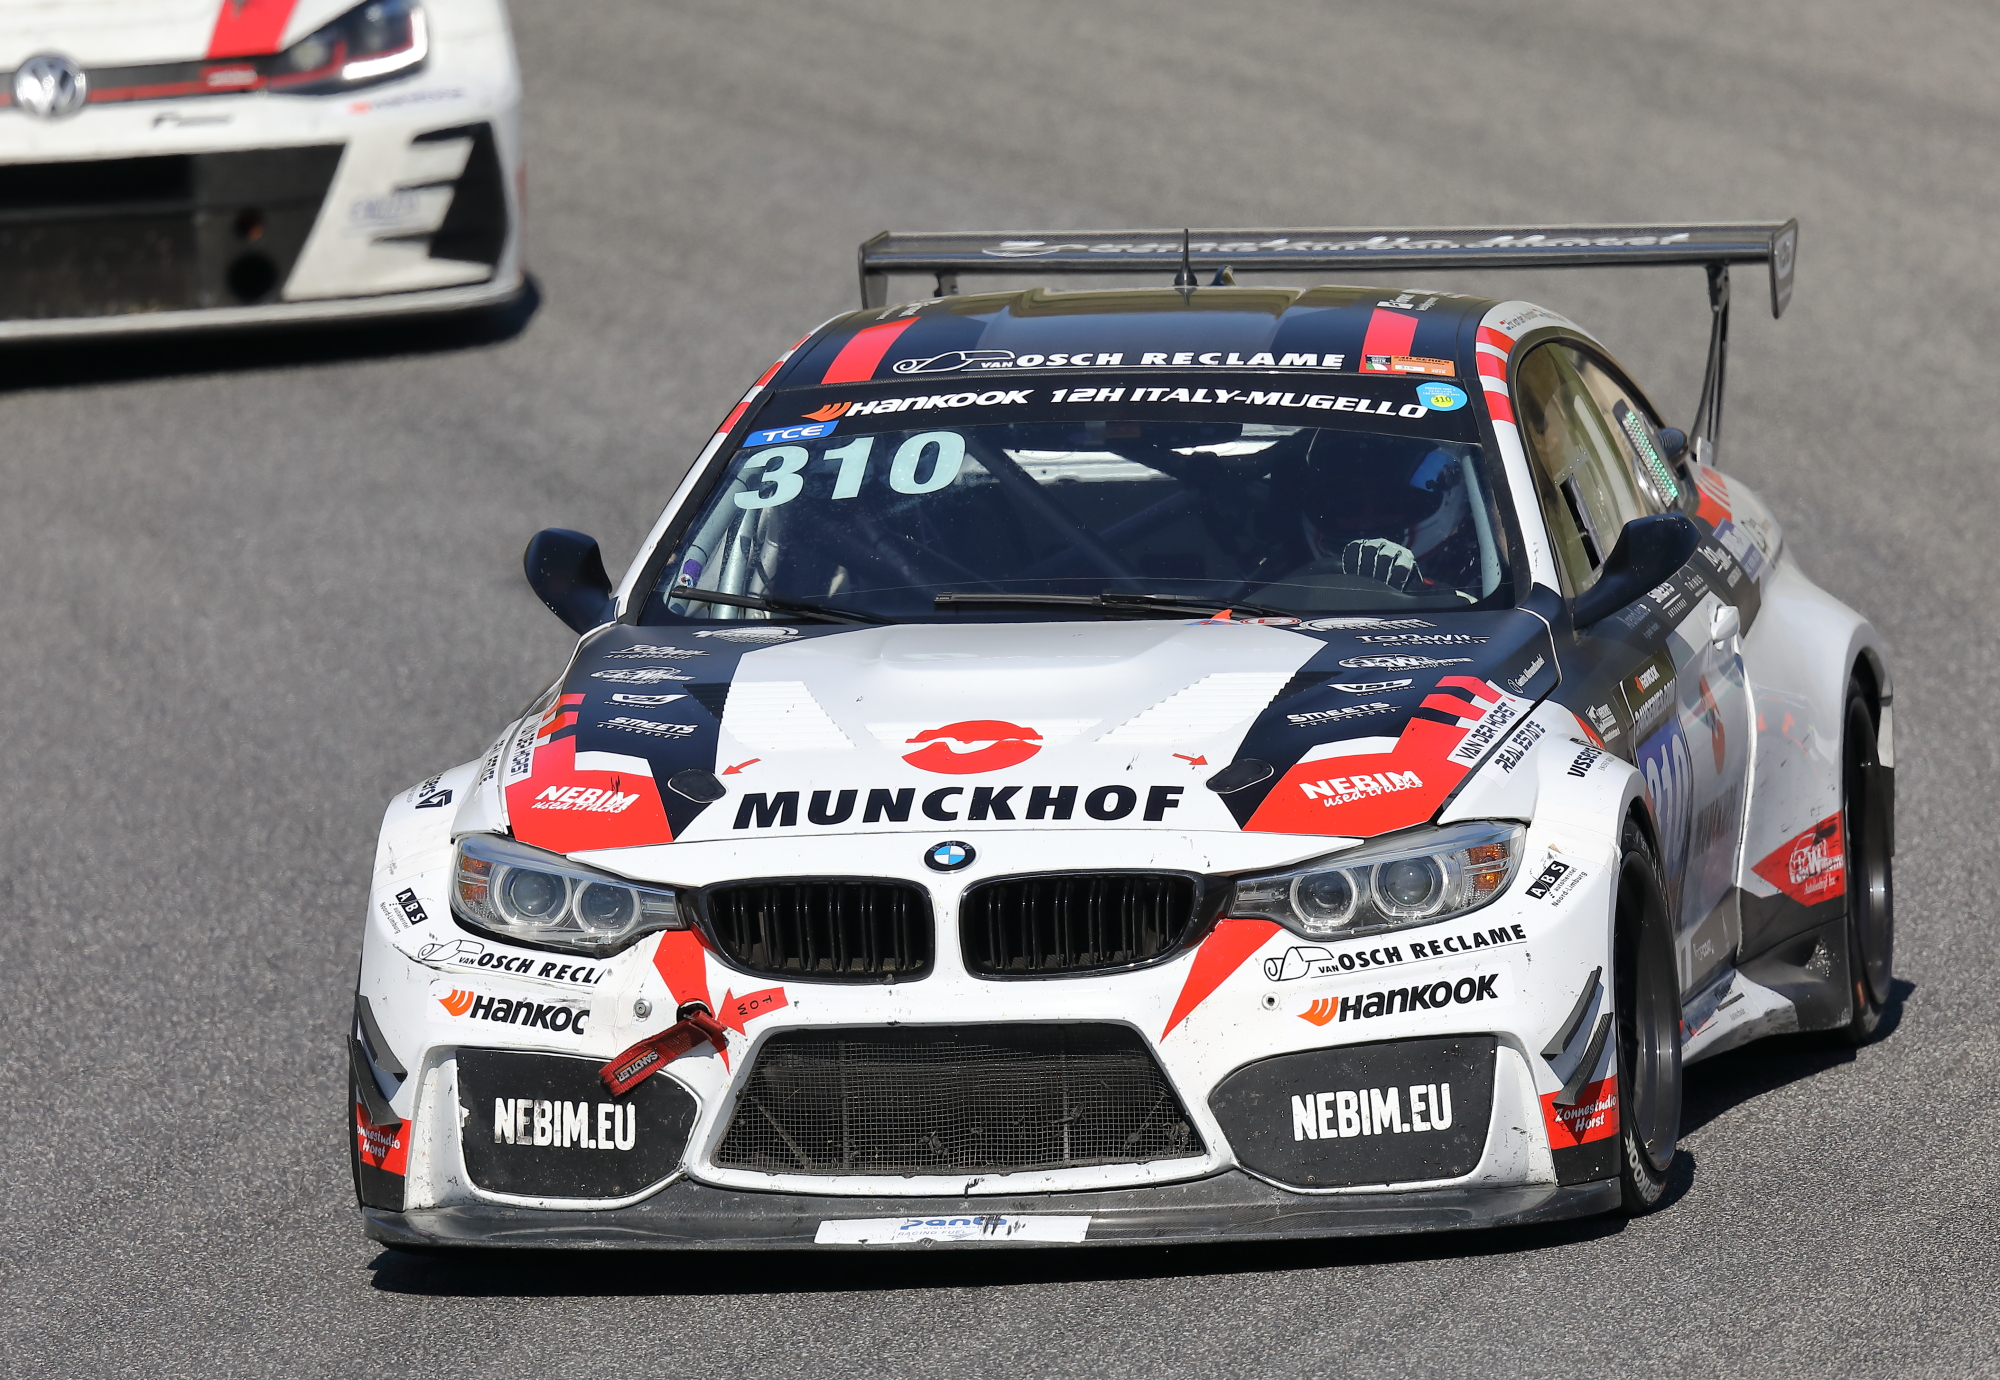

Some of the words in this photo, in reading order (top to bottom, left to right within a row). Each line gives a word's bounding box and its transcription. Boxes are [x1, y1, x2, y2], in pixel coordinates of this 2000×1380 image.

[980, 361, 1014, 369] VAN
[1016, 353, 1124, 367] OSCH
[1140, 352, 1346, 368] RECLAME
[1051, 387, 1127, 403] 12H
[1129, 387, 1428, 419] ITALY-MUGELLO
[762, 425, 825, 442] TCE
[734, 431, 966, 510] 310
[608, 716, 698, 734] SMEETS
[1286, 702, 1391, 724] SMEETS
[1484, 702, 1518, 729] HORST
[1471, 724, 1498, 744] DER
[1495, 745, 1525, 774] REAL
[1512, 720, 1546, 751] ESTATE
[1456, 739, 1485, 760] VAN
[535, 785, 640, 811] NEBIM
[1298, 770, 1419, 799] NEBIM
[1323, 787, 1366, 808] used
[1363, 775, 1424, 798] trucks
[531, 801, 575, 811] used
[732, 785, 1184, 829] MUNCKHOF
[1532, 863, 1567, 897] ABS
[398, 891, 427, 922] ABS
[1318, 964, 1339, 974] VAN
[1338, 946, 1403, 971] OSCH
[1409, 924, 1527, 959] RECLAME
[459, 956, 477, 965] VAN
[477, 952, 536, 974] OSCH
[736, 994, 773, 1016] TOW
[617, 1051, 660, 1083] SANDTLER
[1291, 1082, 1453, 1142] NEBIM.EU
[1555, 1094, 1618, 1122] Zonnestudio
[494, 1097, 636, 1151] NEBIM.EU
[1575, 1112, 1605, 1132] Horst
[362, 1140, 386, 1158] Horst
